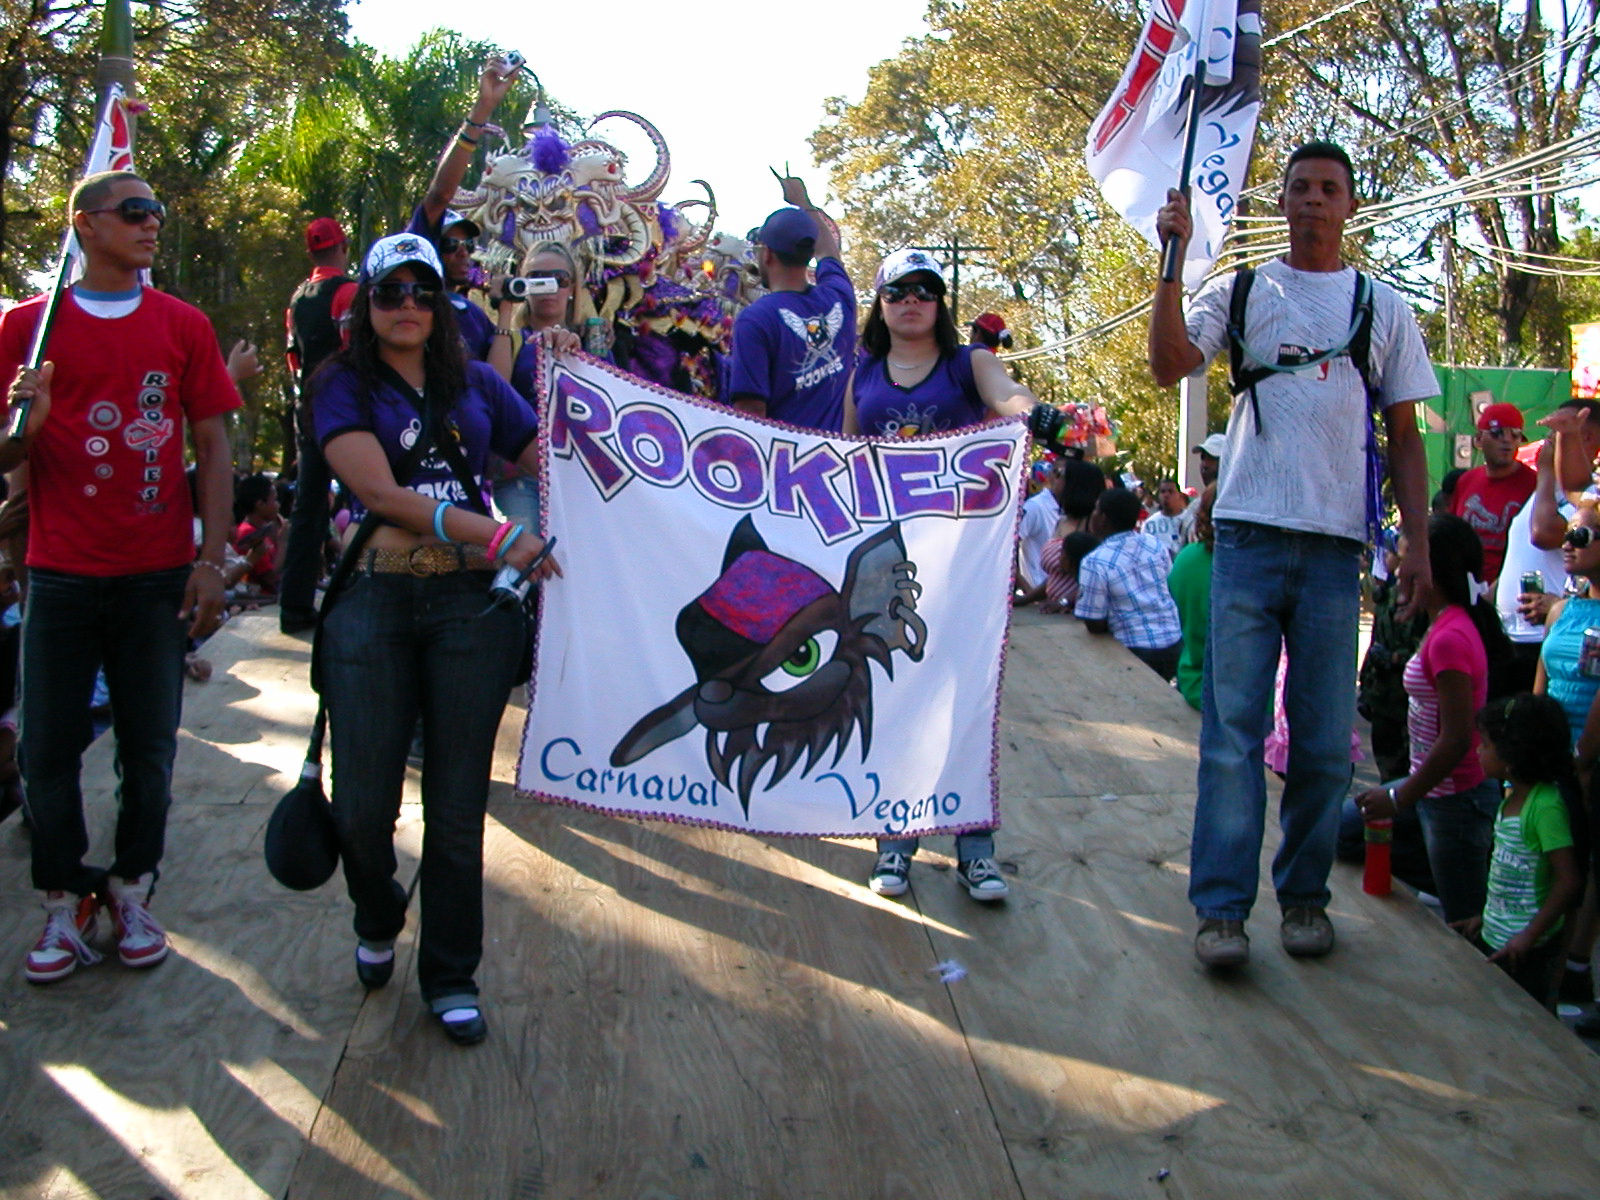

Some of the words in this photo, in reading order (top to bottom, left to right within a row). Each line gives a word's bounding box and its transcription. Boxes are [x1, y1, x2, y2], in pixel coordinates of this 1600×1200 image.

[551, 366, 1017, 545] ROOKIES
[540, 737, 719, 807] Carnaval
[814, 771, 962, 835] Vegano
